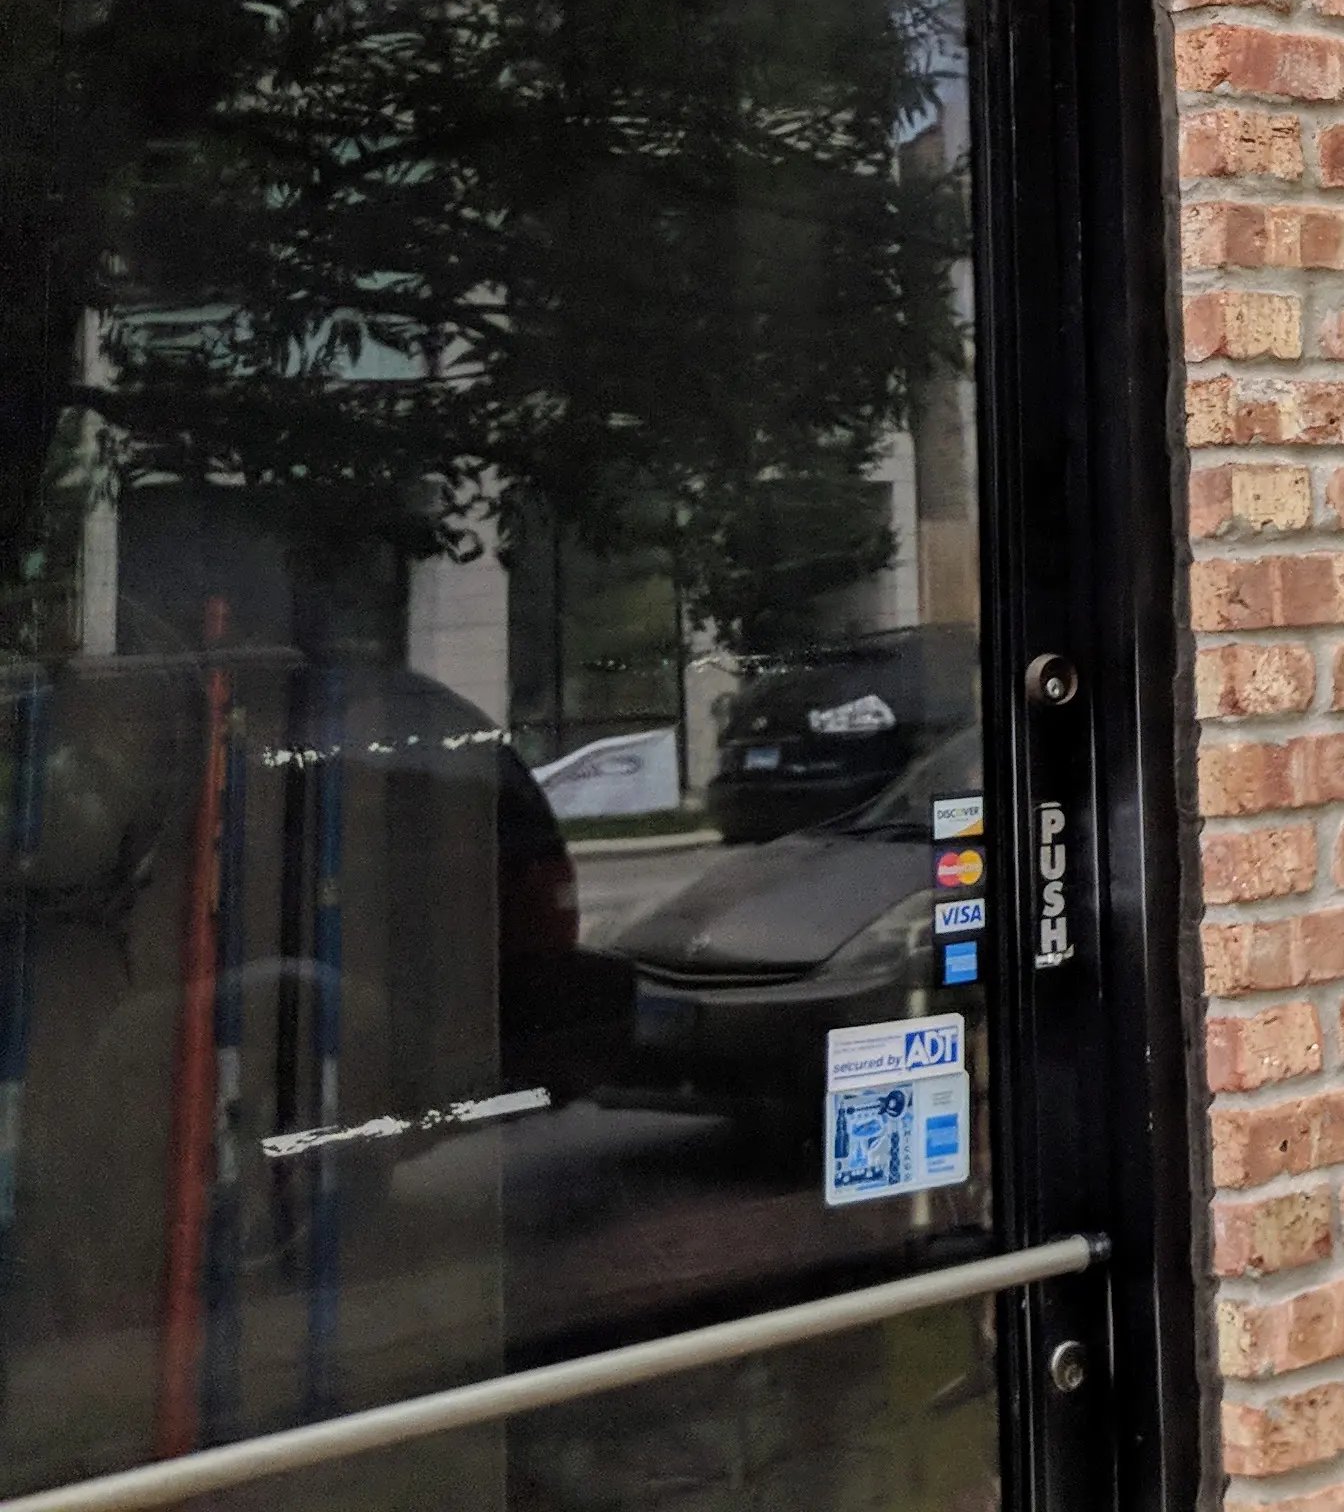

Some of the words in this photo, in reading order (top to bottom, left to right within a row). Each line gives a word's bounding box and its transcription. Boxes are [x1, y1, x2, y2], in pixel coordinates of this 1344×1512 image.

[937, 806, 980, 820] DISCOVER
[1039, 808, 1068, 954] PUSH
[942, 905, 982, 926] VISA
[833, 1055, 884, 1073] secured
[887, 1054, 903, 1068] by
[905, 1028, 958, 1068] ADT
